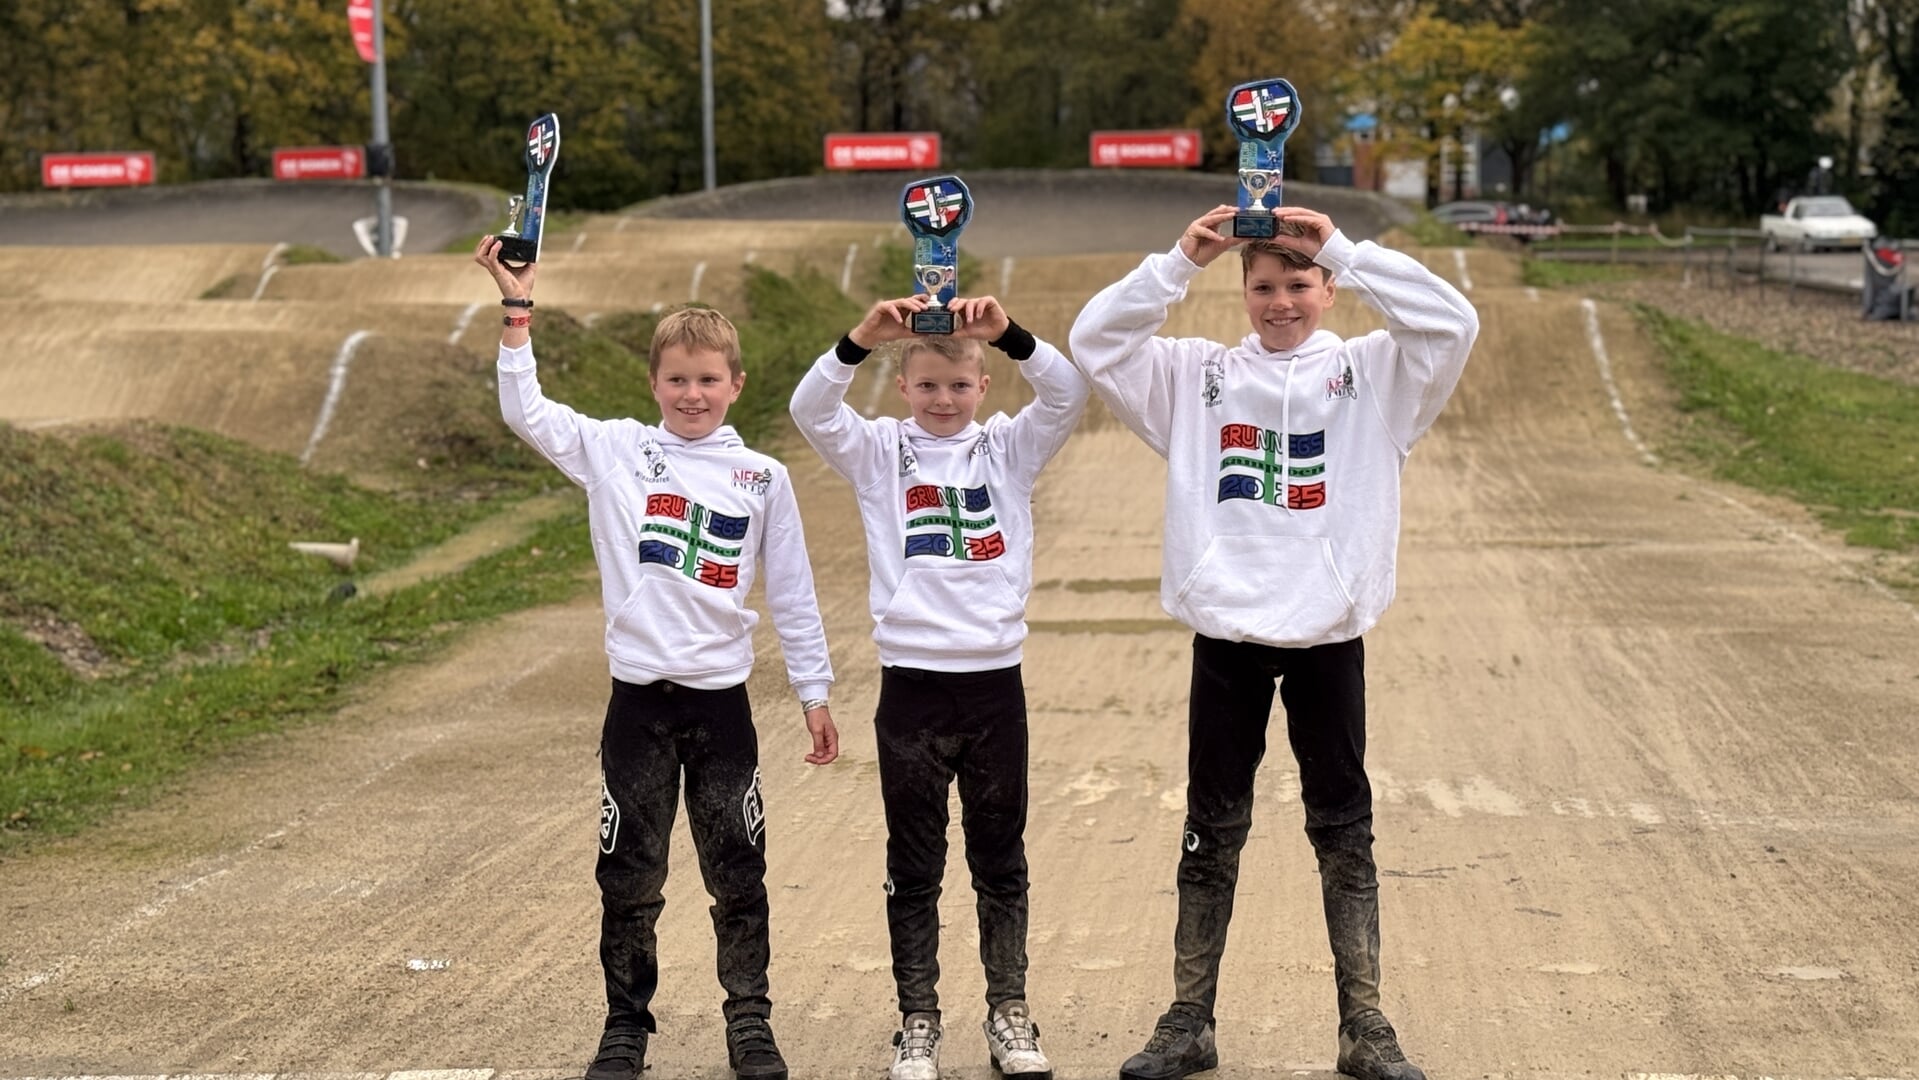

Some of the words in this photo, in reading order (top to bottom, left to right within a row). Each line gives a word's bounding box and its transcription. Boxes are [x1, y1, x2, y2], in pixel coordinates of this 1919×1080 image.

[1221, 456, 1326, 477] kampoen
[905, 484, 992, 514] GRUNNEGS
[644, 492, 750, 541] GRUNNEGS
